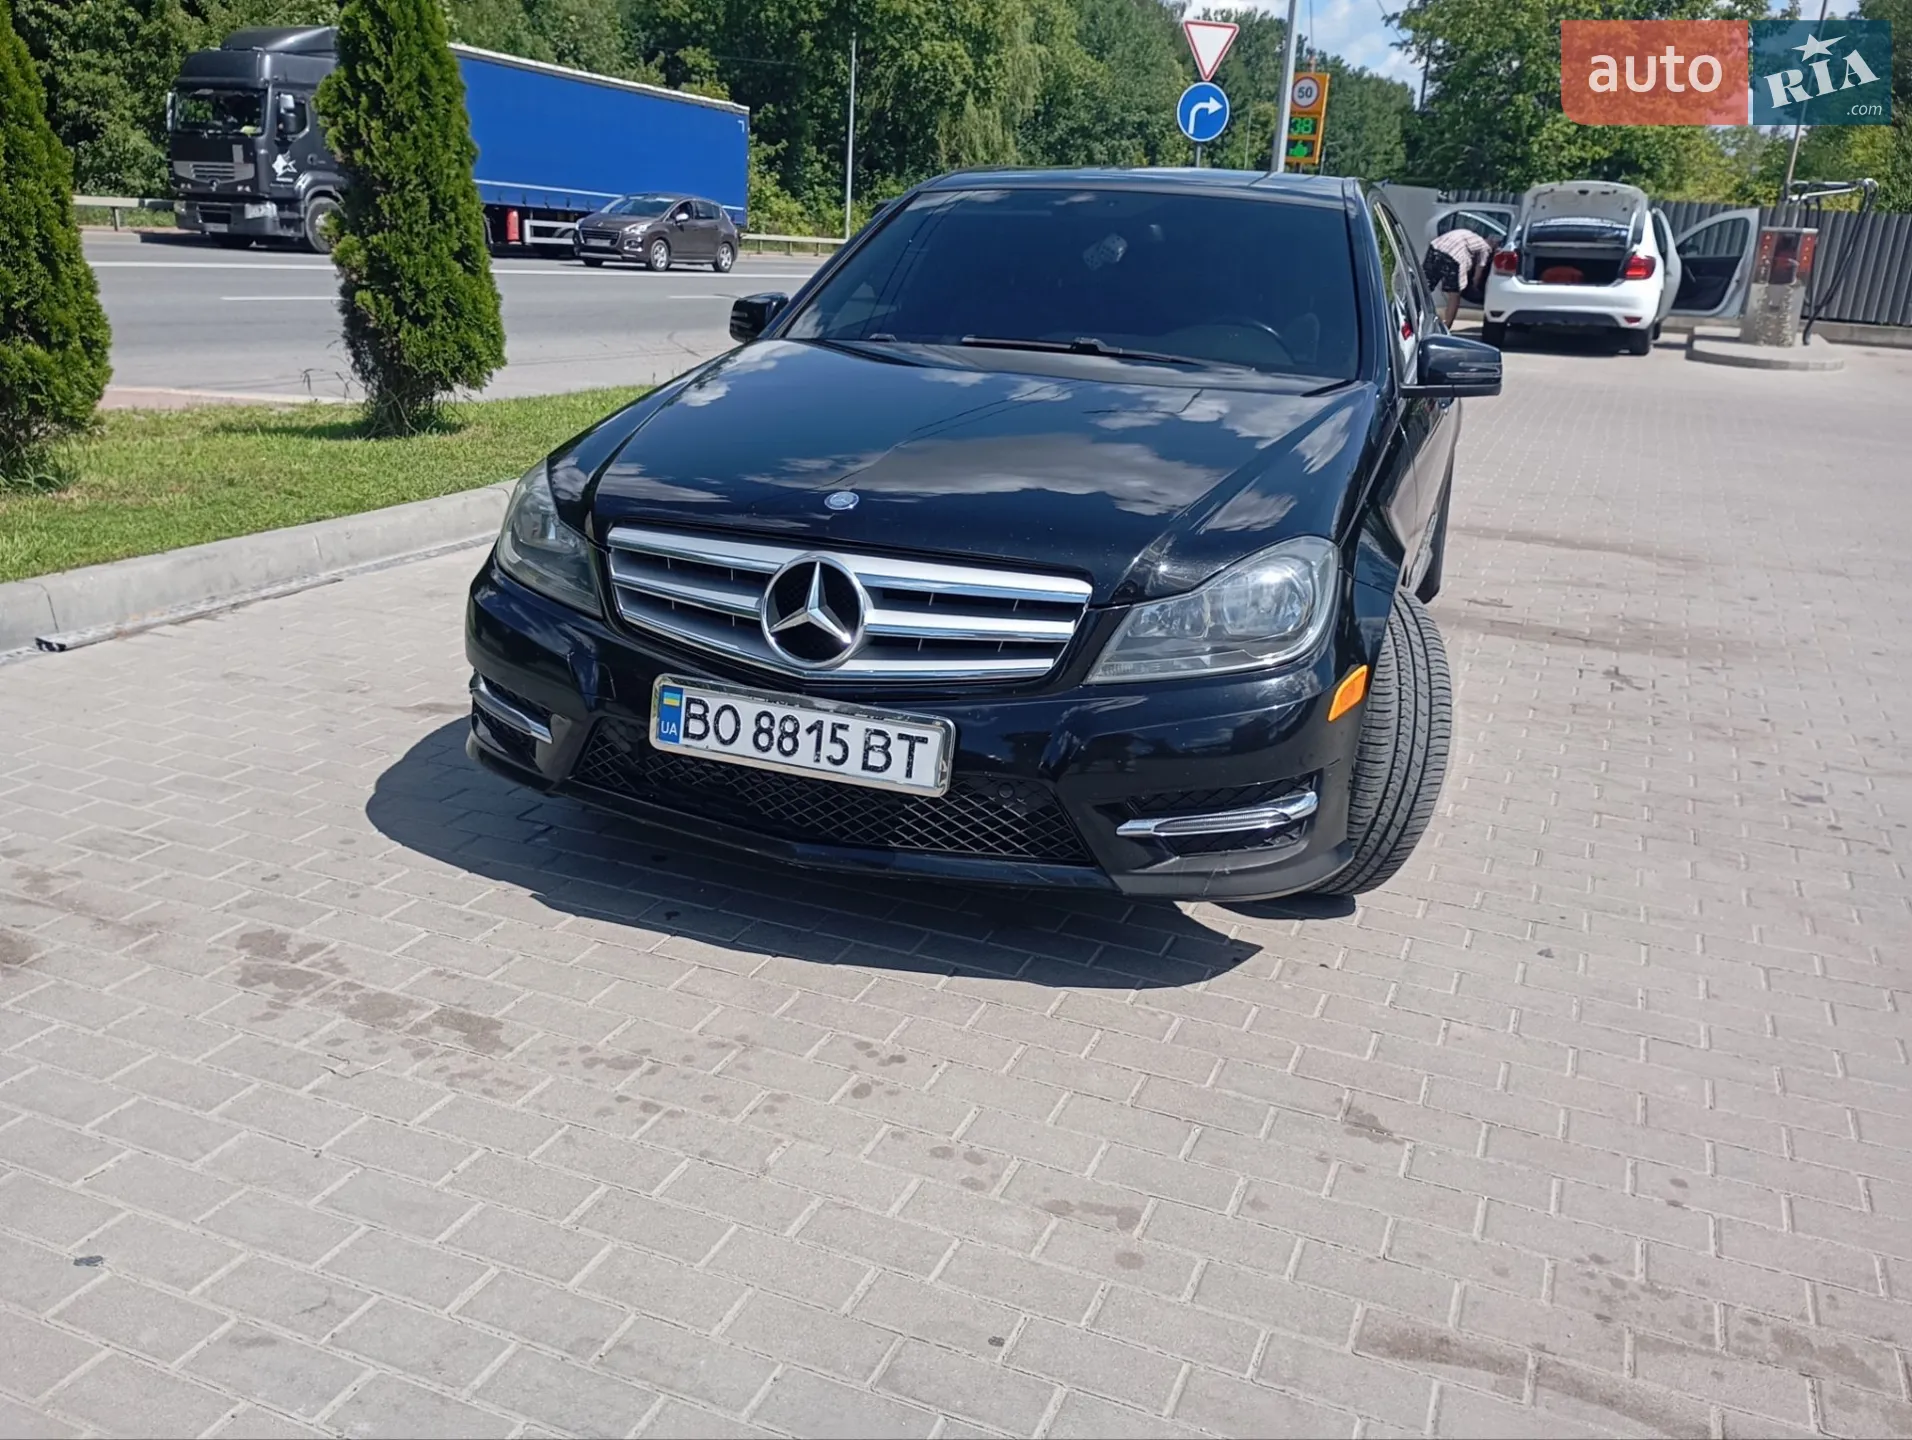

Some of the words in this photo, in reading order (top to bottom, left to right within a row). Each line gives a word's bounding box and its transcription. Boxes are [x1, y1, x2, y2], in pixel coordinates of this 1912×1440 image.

[1297, 86, 1314, 99] 50
[1290, 117, 1313, 136] 38
[660, 720, 678, 736] UA
[682, 696, 741, 746] BO
[752, 710, 850, 766] 8815
[861, 727, 929, 779] BT
